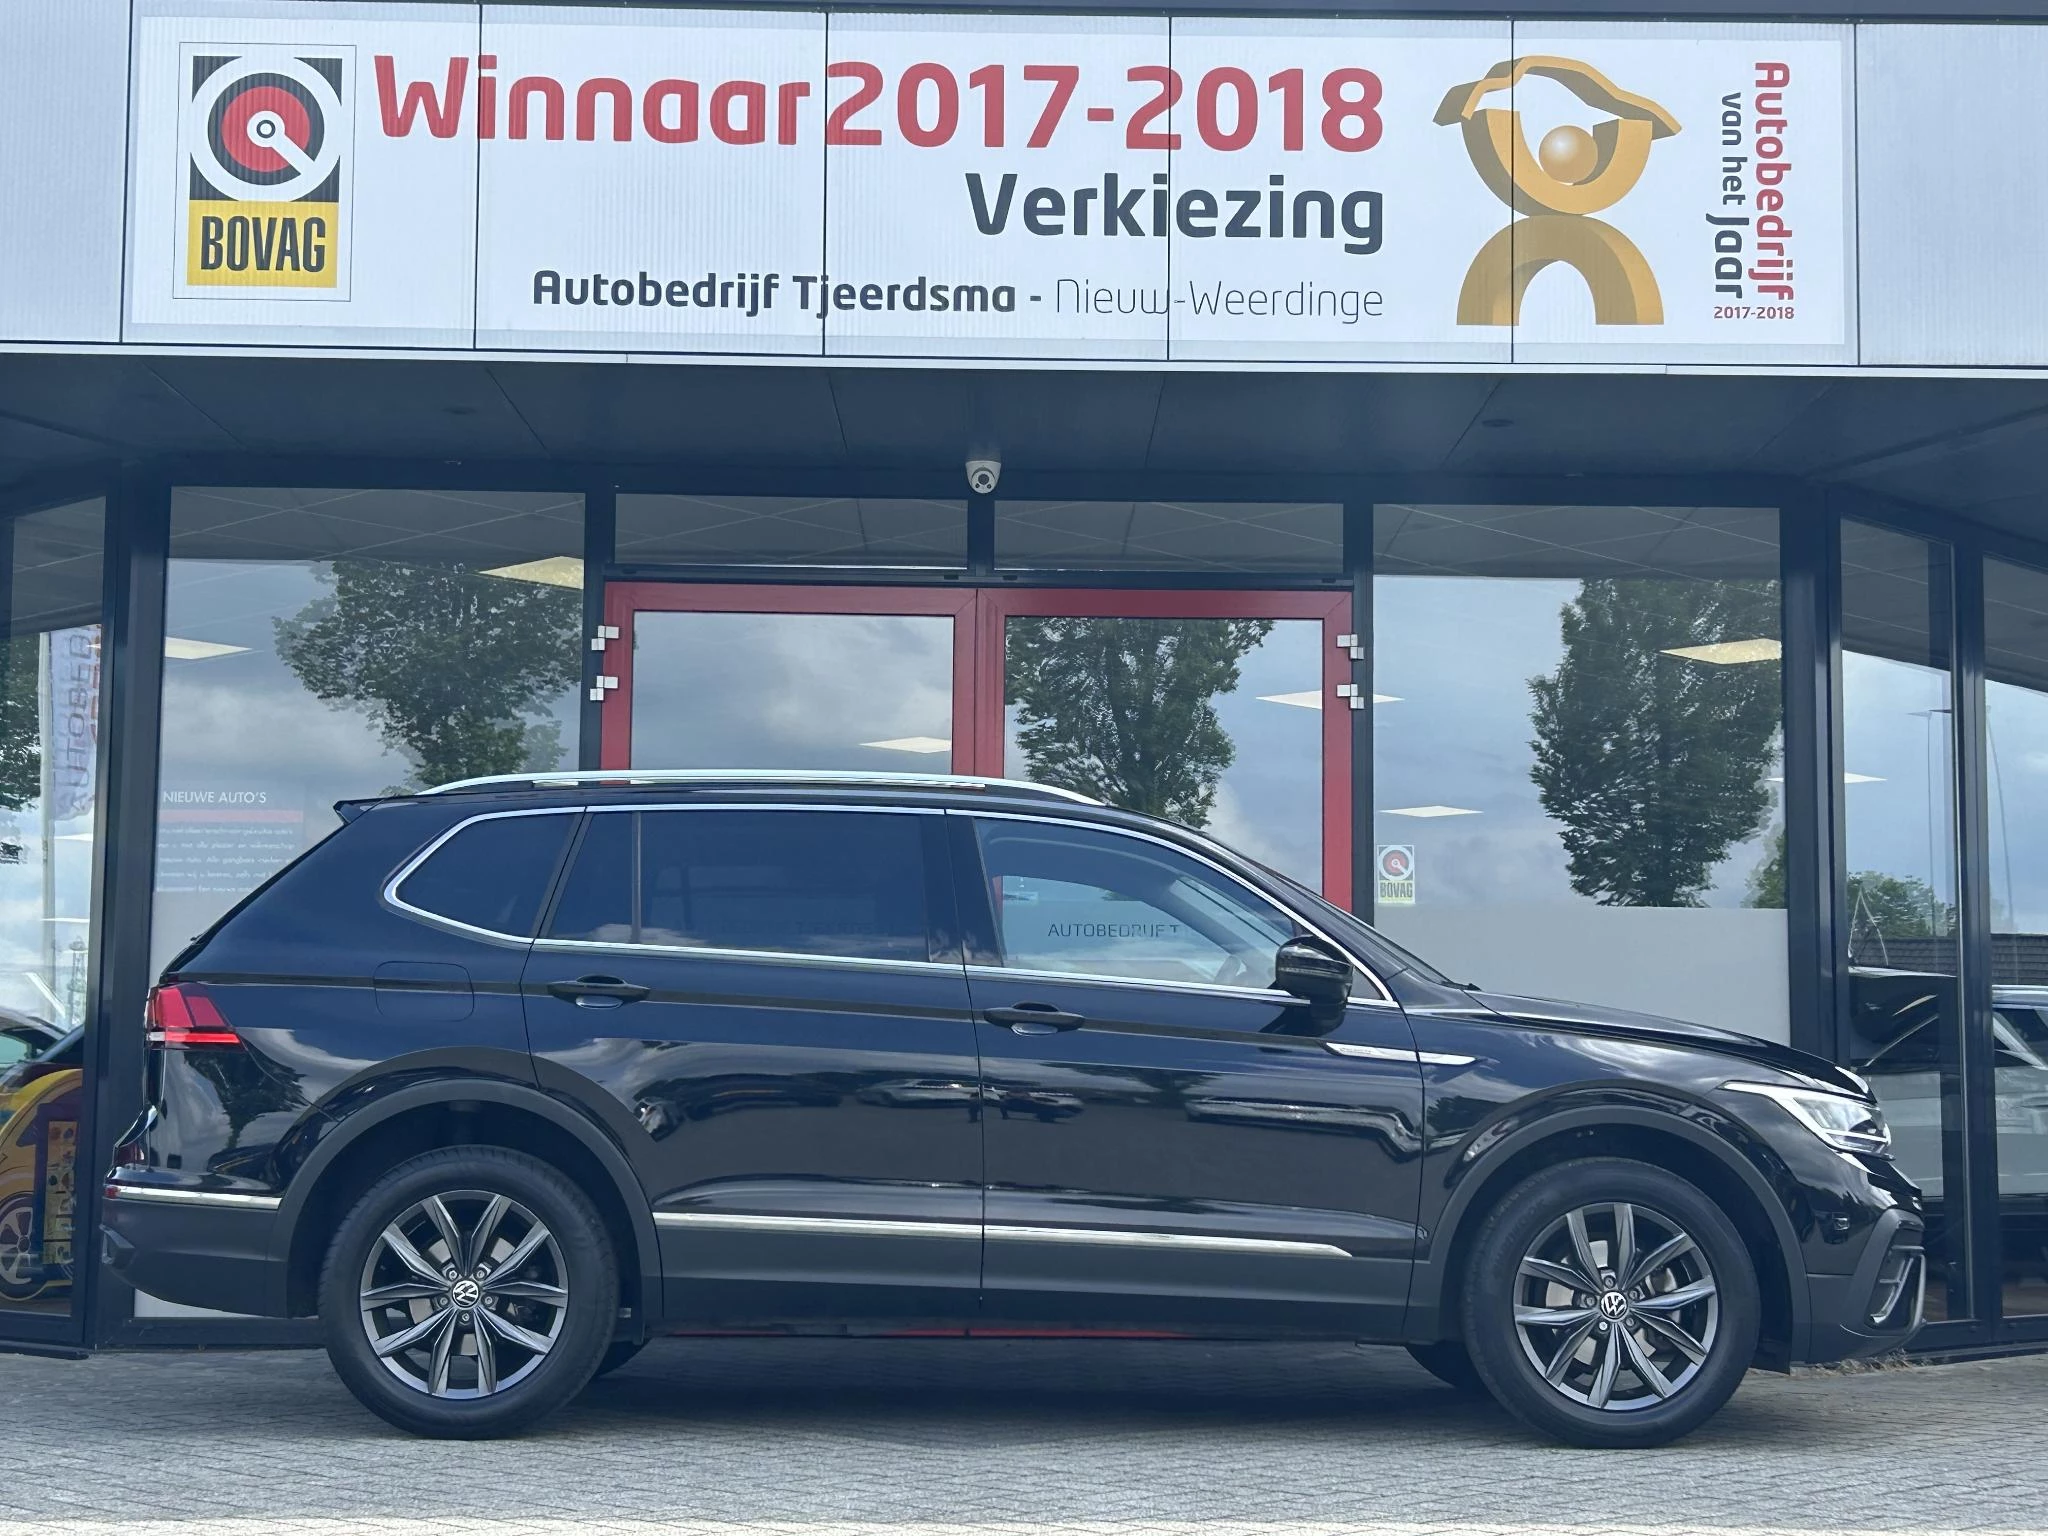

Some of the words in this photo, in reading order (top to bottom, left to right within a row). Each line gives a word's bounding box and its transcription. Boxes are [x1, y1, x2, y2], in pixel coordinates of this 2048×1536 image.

[374, 55, 810, 145] Winnaar
[825, 61, 1383, 152] 2017-2018
[1721, 91, 1743, 146] van
[1721, 156, 1747, 206] het
[1747, 62, 1794, 301] Autobedrijf
[964, 172, 1383, 256] Verkiezing
[200, 215, 326, 273] BOVAG
[1705, 212, 1750, 300] Jaar
[533, 269, 780, 318] Autobedrijf
[792, 275, 1016, 326] Tjeerdsma
[1056, 278, 1383, 326] Nieuw-Weerdinge
[1713, 306, 1795, 320] 2017-2018
[162, 790, 215, 804] NIEUWE
[1379, 881, 1414, 899] BOVAG
